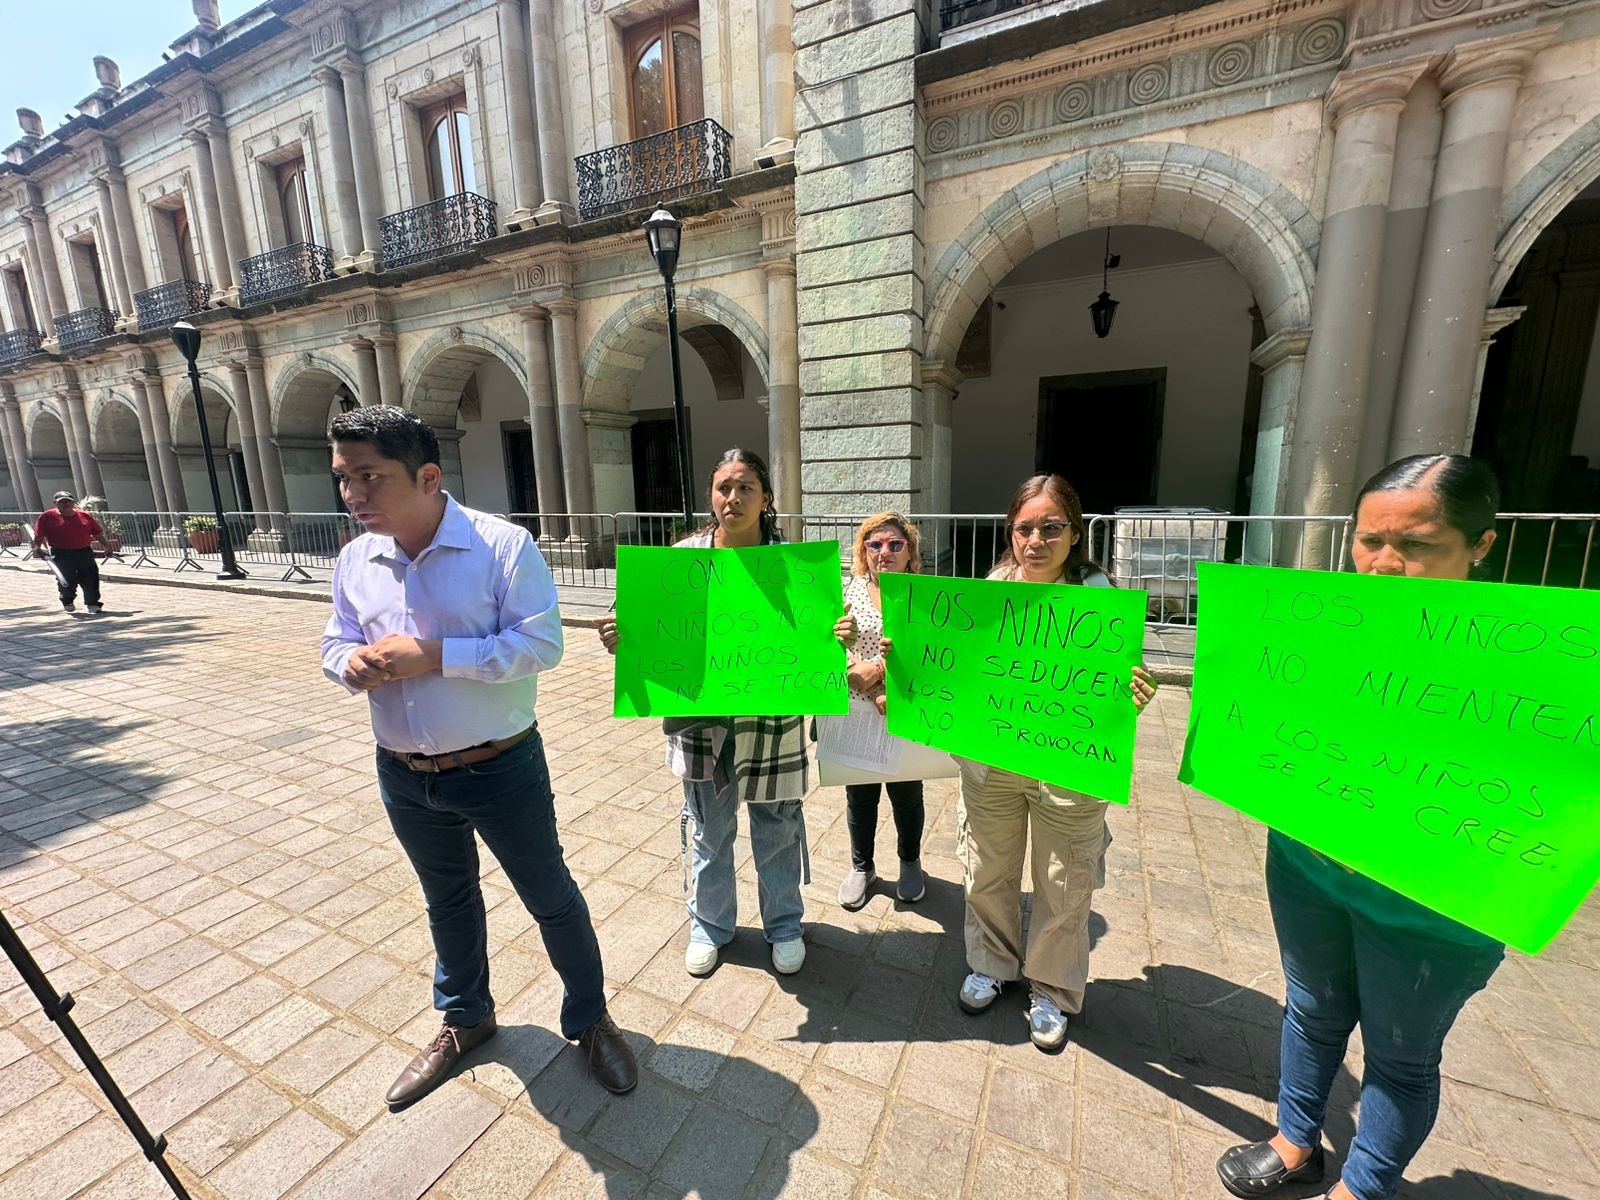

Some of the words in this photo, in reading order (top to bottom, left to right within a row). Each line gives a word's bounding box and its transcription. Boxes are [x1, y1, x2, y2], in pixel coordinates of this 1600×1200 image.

[661, 559, 724, 596] CON
[752, 557, 815, 586] LOS
[656, 610, 759, 642] NIÑOS
[779, 605, 815, 633] NO
[906, 582, 975, 632] LOS
[997, 596, 1125, 653] NIÑOS
[1261, 588, 1364, 628] LOS
[1416, 607, 1598, 659] NIÑOS
[636, 657, 685, 676] LOS
[709, 645, 798, 671] NIÑOS
[921, 643, 955, 671] NO
[981, 655, 1134, 701] SEDUCEN
[676, 684, 705, 700] NO
[723, 679, 758, 697] SE
[907, 679, 954, 701] LOS
[987, 693, 1094, 729] NIÑOS
[1257, 645, 1307, 684] NO
[1355, 670, 1600, 746] MIENTEN
[918, 707, 954, 730] NO
[987, 718, 1117, 763] PROVOCAN
[1226, 700, 1244, 732] A
[1275, 721, 1348, 762] LOS
[1371, 751, 1544, 818] NIÑOS
[1257, 753, 1296, 776] SE
[1316, 776, 1375, 809] LES
